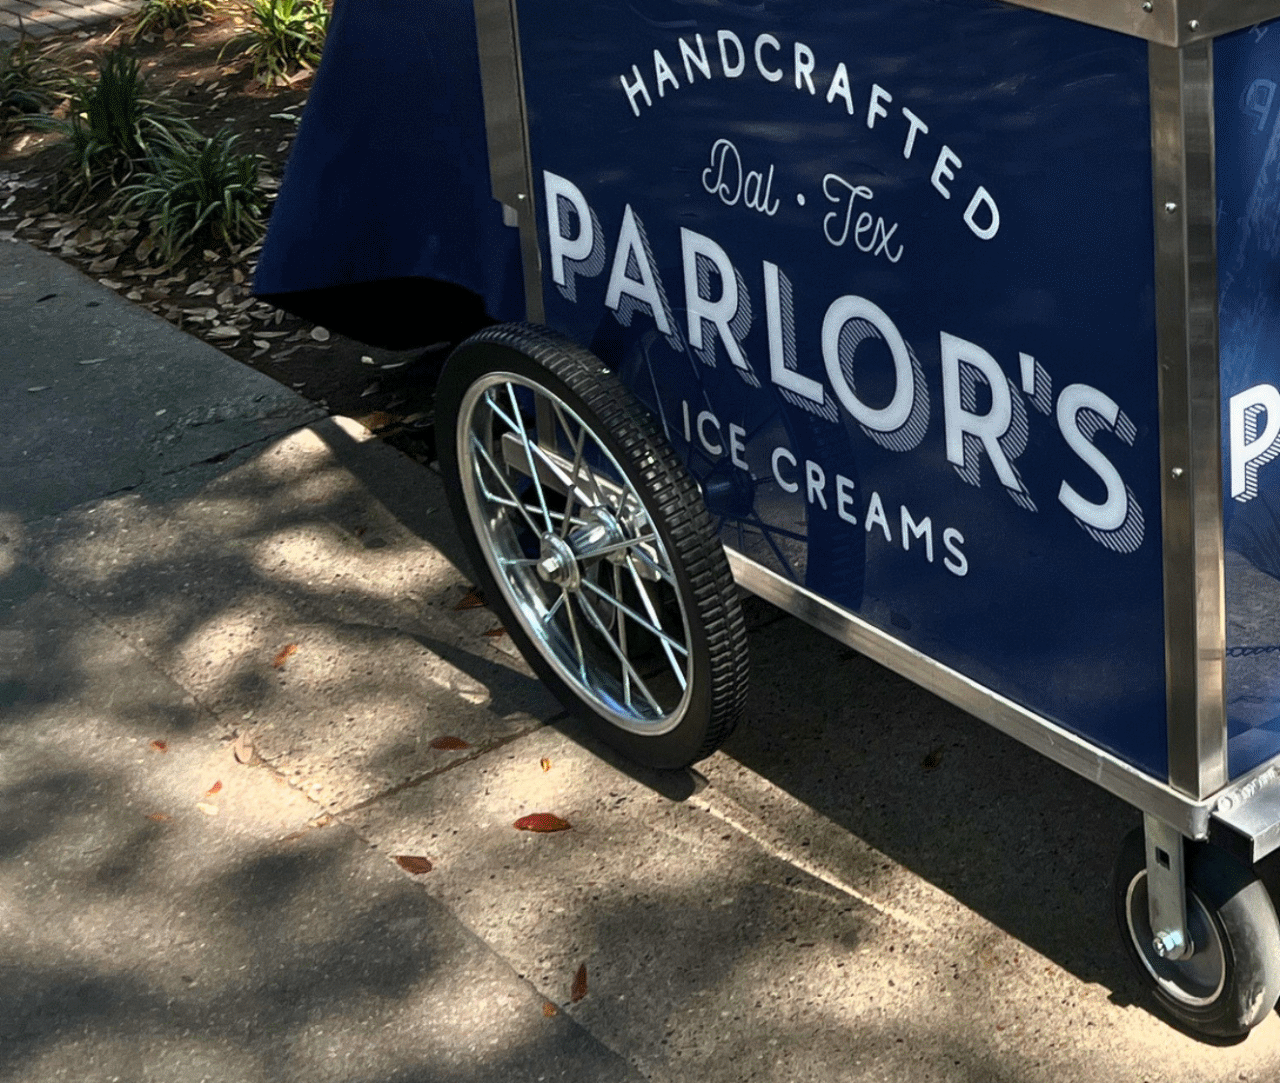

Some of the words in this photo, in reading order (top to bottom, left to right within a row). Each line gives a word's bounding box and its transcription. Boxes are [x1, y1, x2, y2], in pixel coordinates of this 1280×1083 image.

[620, 28, 1001, 241] HANDCRAFTED
[702, 138, 780, 216] Dal
[822, 173, 904, 263] Tex
[543, 169, 1145, 554] PARLOR'S
[682, 400, 749, 471] ICE
[771, 446, 970, 577] CREAMS
